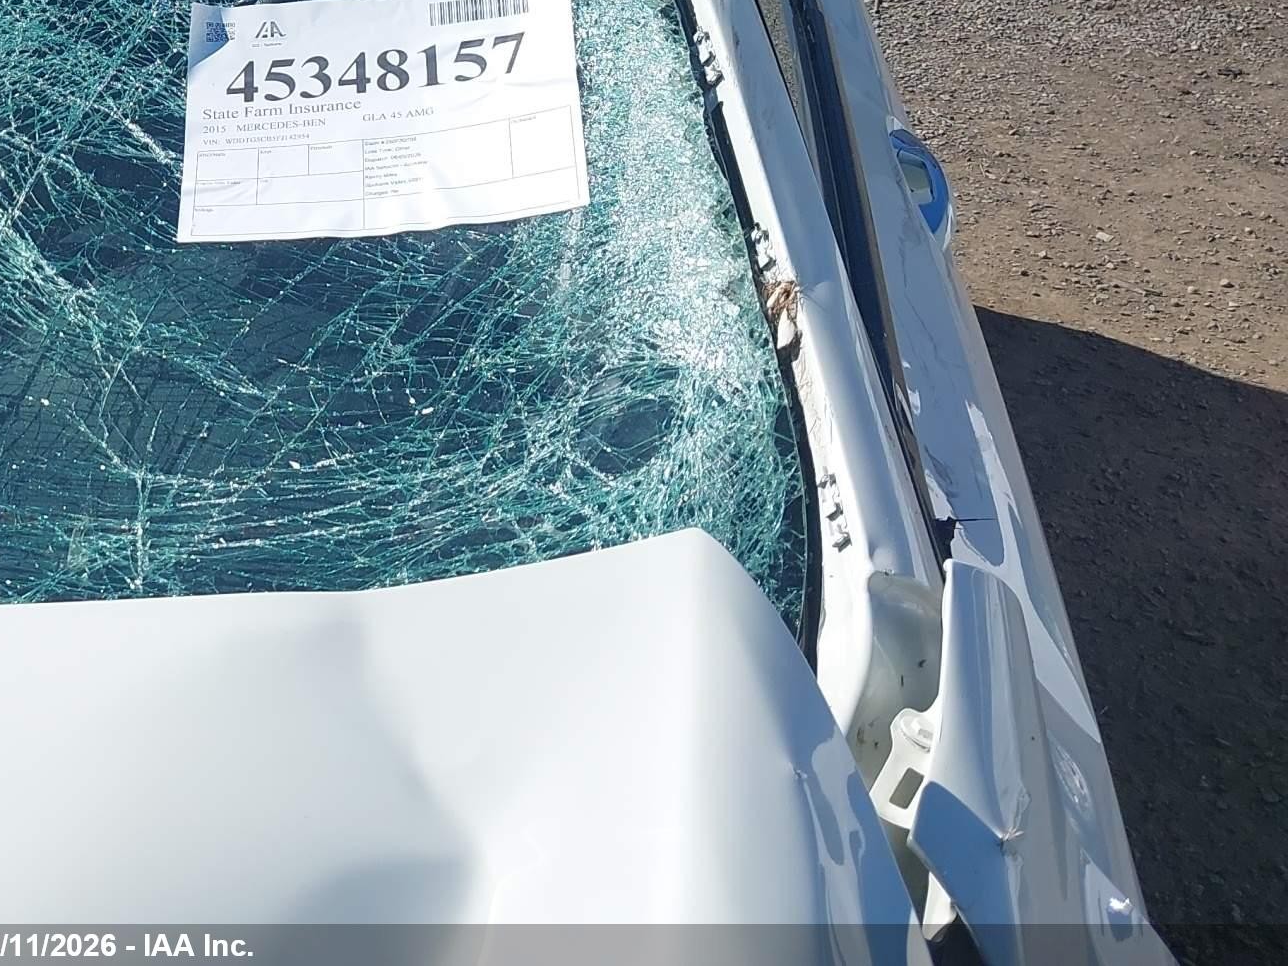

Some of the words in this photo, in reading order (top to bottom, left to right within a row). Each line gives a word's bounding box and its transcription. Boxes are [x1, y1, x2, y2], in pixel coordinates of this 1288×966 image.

[226, 31, 525, 103] 45348157
[202, 108, 239, 121] State
[244, 105, 283, 118] Farm
[289, 100, 362, 115] Insurance
[362, 113, 387, 122] GLA
[390, 111, 402, 119] 45
[406, 107, 434, 118] AMG
[202, 125, 227, 134] 2015
[236, 118, 327, 133] MERCEDES-BEN
